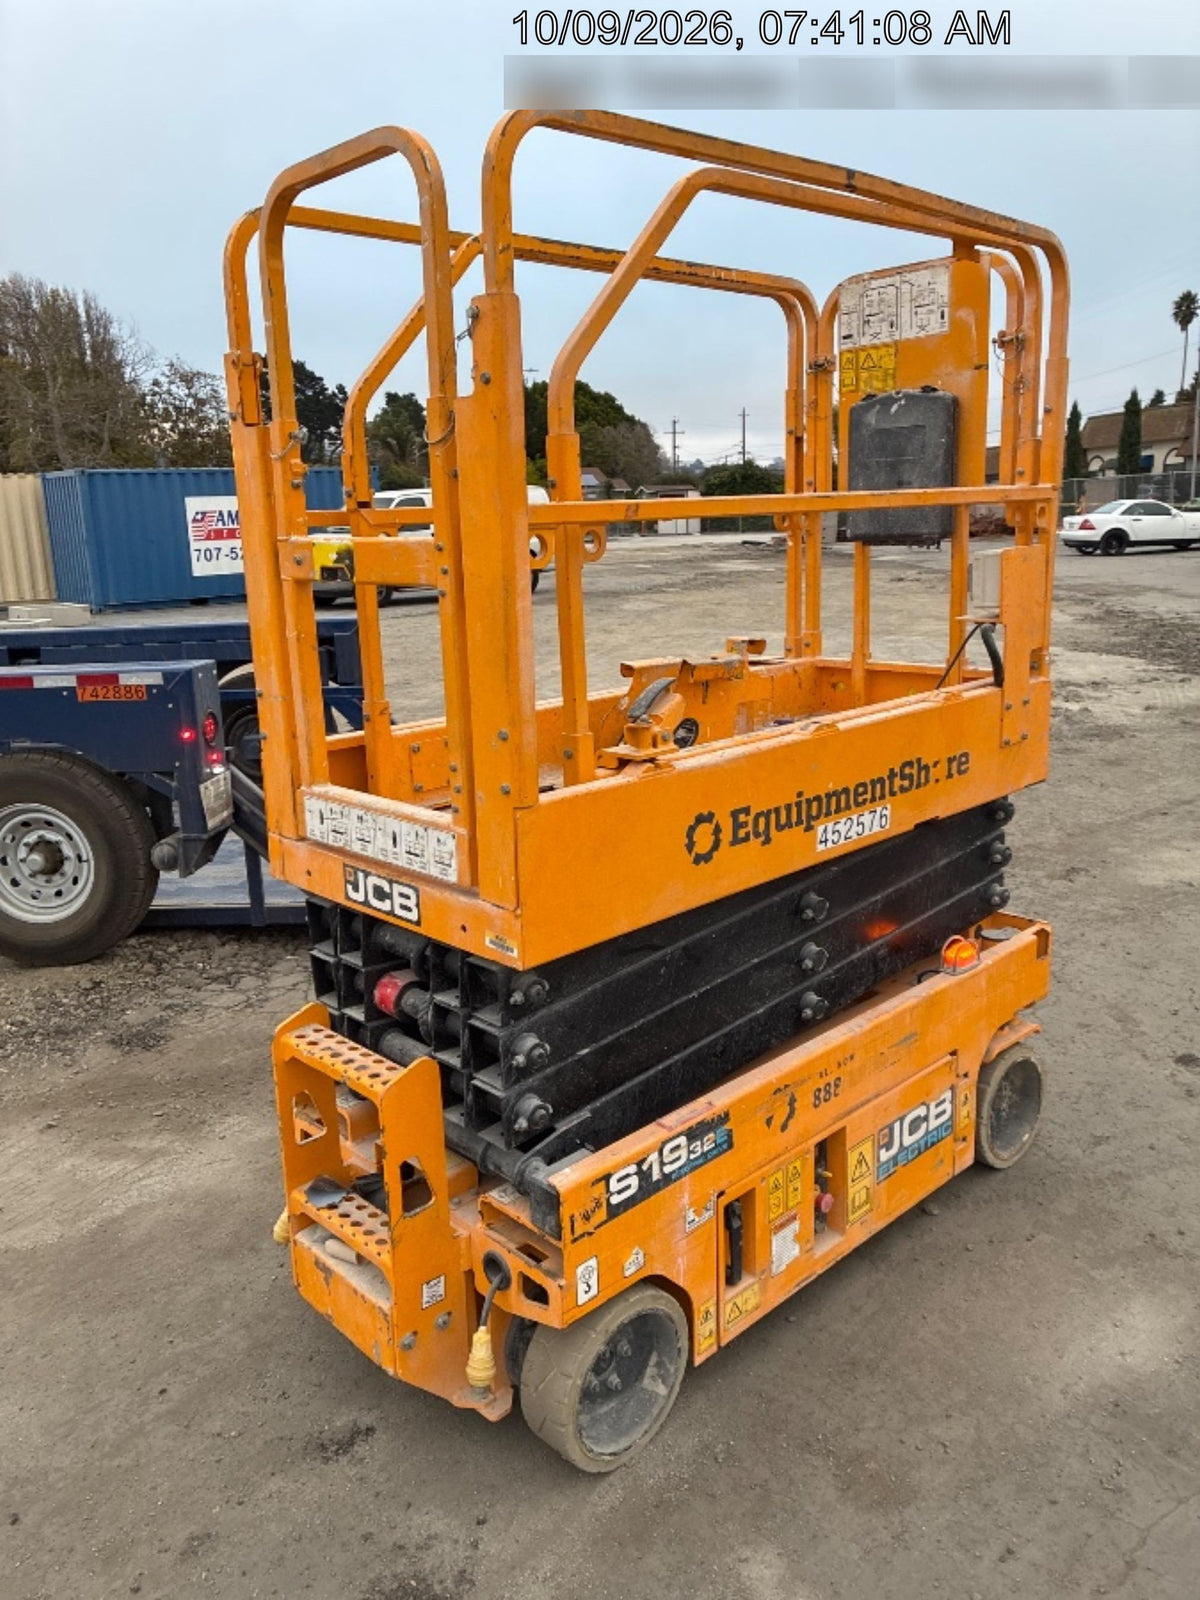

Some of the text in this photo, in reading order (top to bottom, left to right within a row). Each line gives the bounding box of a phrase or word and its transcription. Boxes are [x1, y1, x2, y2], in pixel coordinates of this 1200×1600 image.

[79, 685, 145, 701] 742886
[728, 751, 970, 847] EquipmentShre
[818, 806, 888, 847] 452576
[346, 870, 419, 922] JCB
[878, 1120, 952, 1178] ELECTRIC
[880, 1089, 952, 1162] JCB
